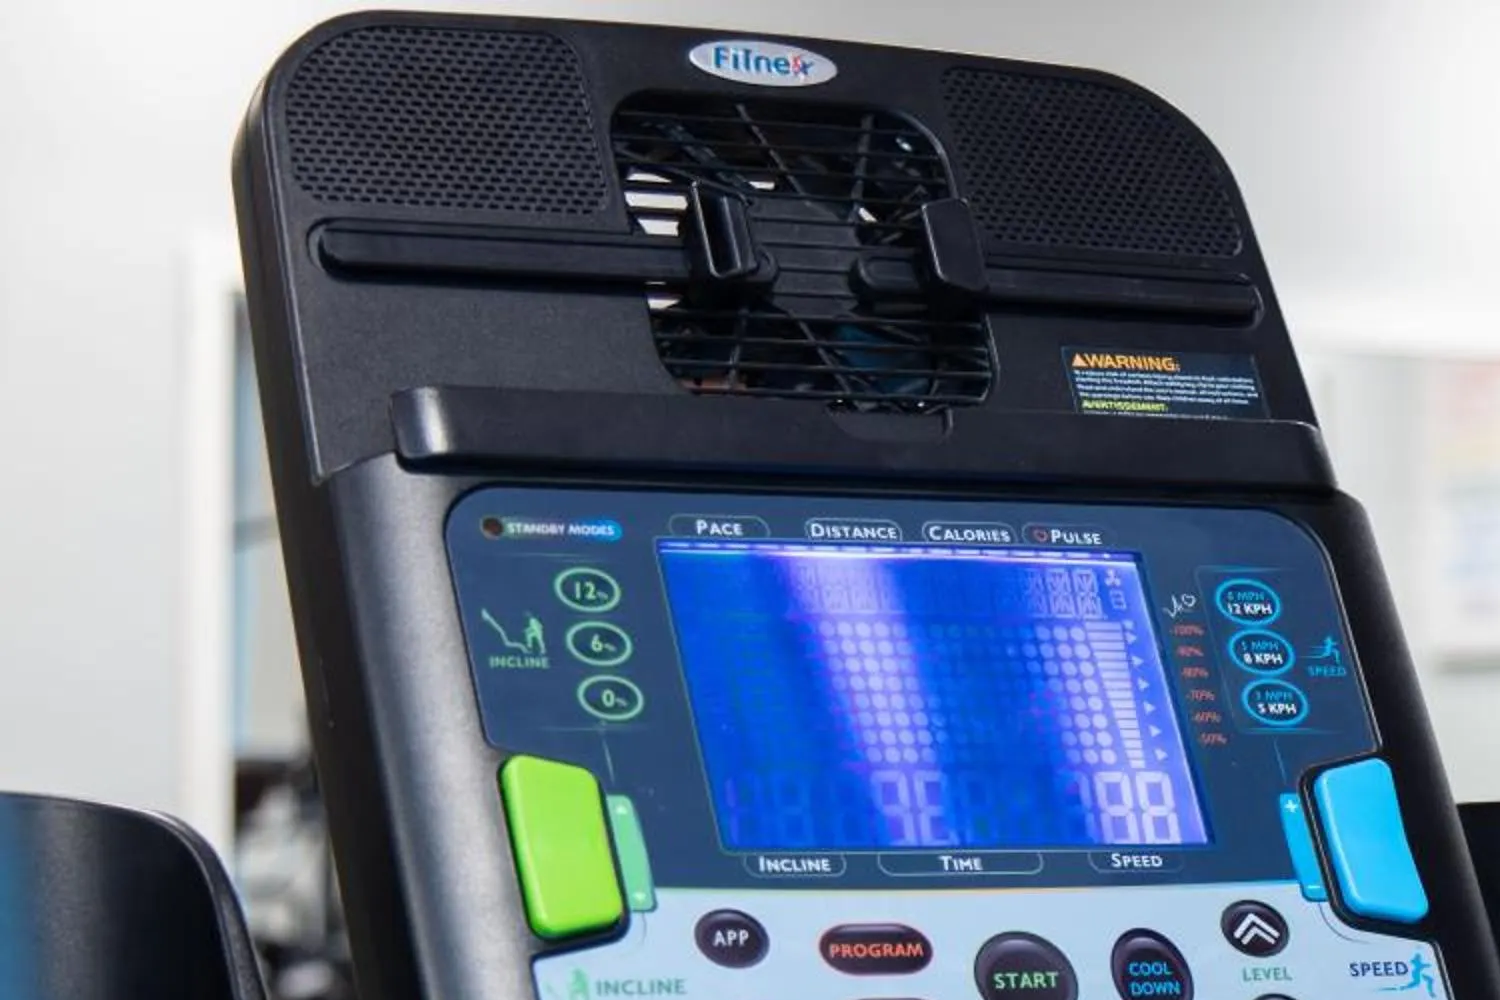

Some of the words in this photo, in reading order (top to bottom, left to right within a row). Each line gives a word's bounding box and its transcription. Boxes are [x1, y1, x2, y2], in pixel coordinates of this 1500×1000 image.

[506, 521, 564, 535] STANDBY
[568, 523, 615, 536] MODES
[1227, 603, 1241, 615] 12
[1244, 602, 1272, 615] KPH
[489, 656, 550, 669] INCLINE
[1254, 652, 1283, 665] KPH
[1308, 666, 1346, 677] SPEED
[1268, 703, 1297, 715] KPH
[712, 929, 750, 948] APP
[829, 942, 925, 958] PROGRAM
[1128, 960, 1172, 977] COOL
[1242, 966, 1294, 983] LEVEL
[1349, 960, 1409, 977] SPEED
[596, 977, 688, 998] INCLINE
[992, 970, 1060, 991] START
[1130, 981, 1182, 998] DOWN
